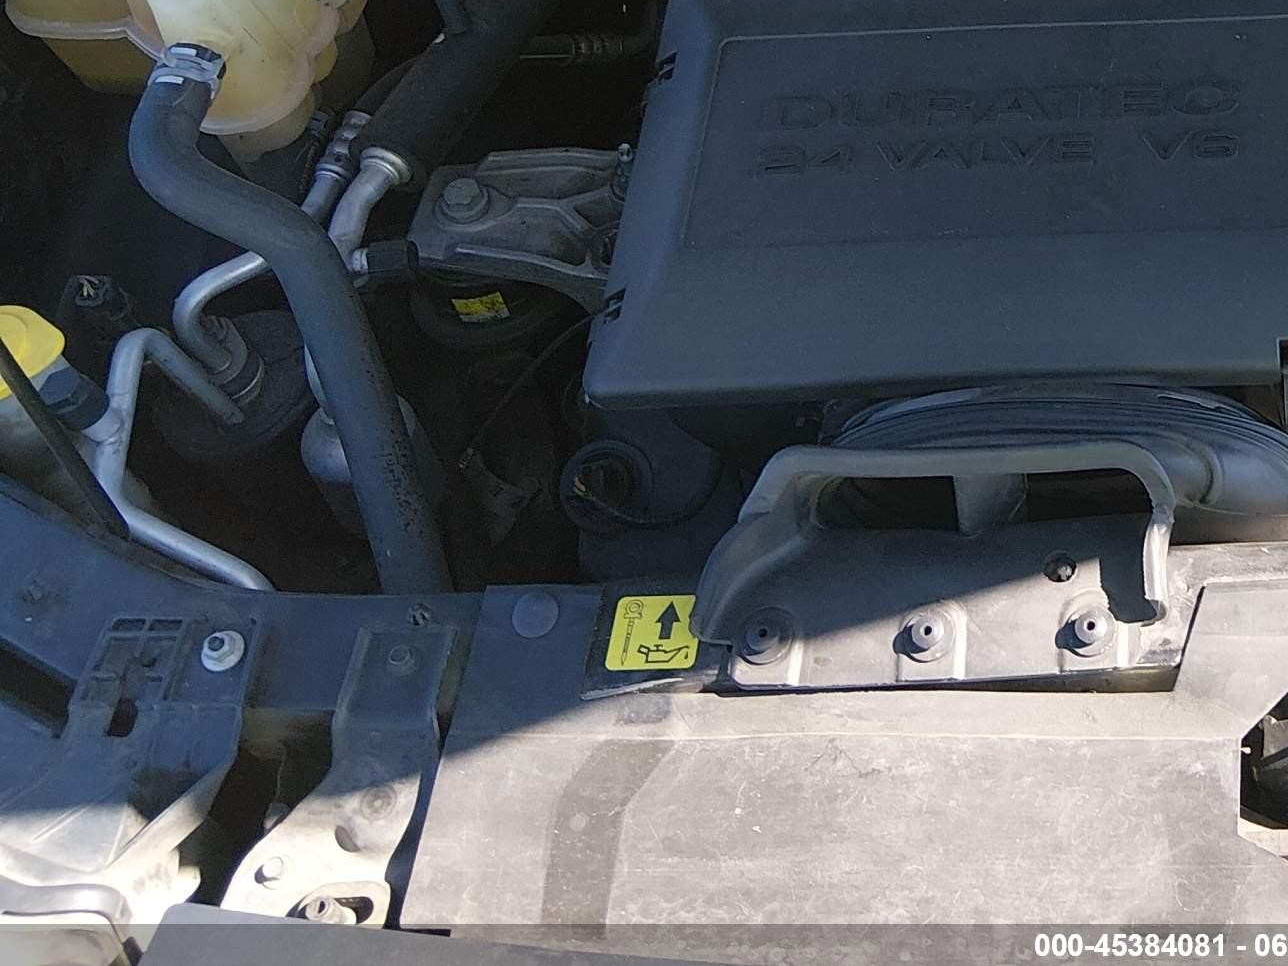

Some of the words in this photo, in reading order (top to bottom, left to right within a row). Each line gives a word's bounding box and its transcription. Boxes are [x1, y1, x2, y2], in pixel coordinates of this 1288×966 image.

[767, 82, 1240, 130] DURATEC
[756, 143, 854, 177] 24
[874, 133, 1096, 172] VALVE
[1140, 130, 1240, 162] V6
